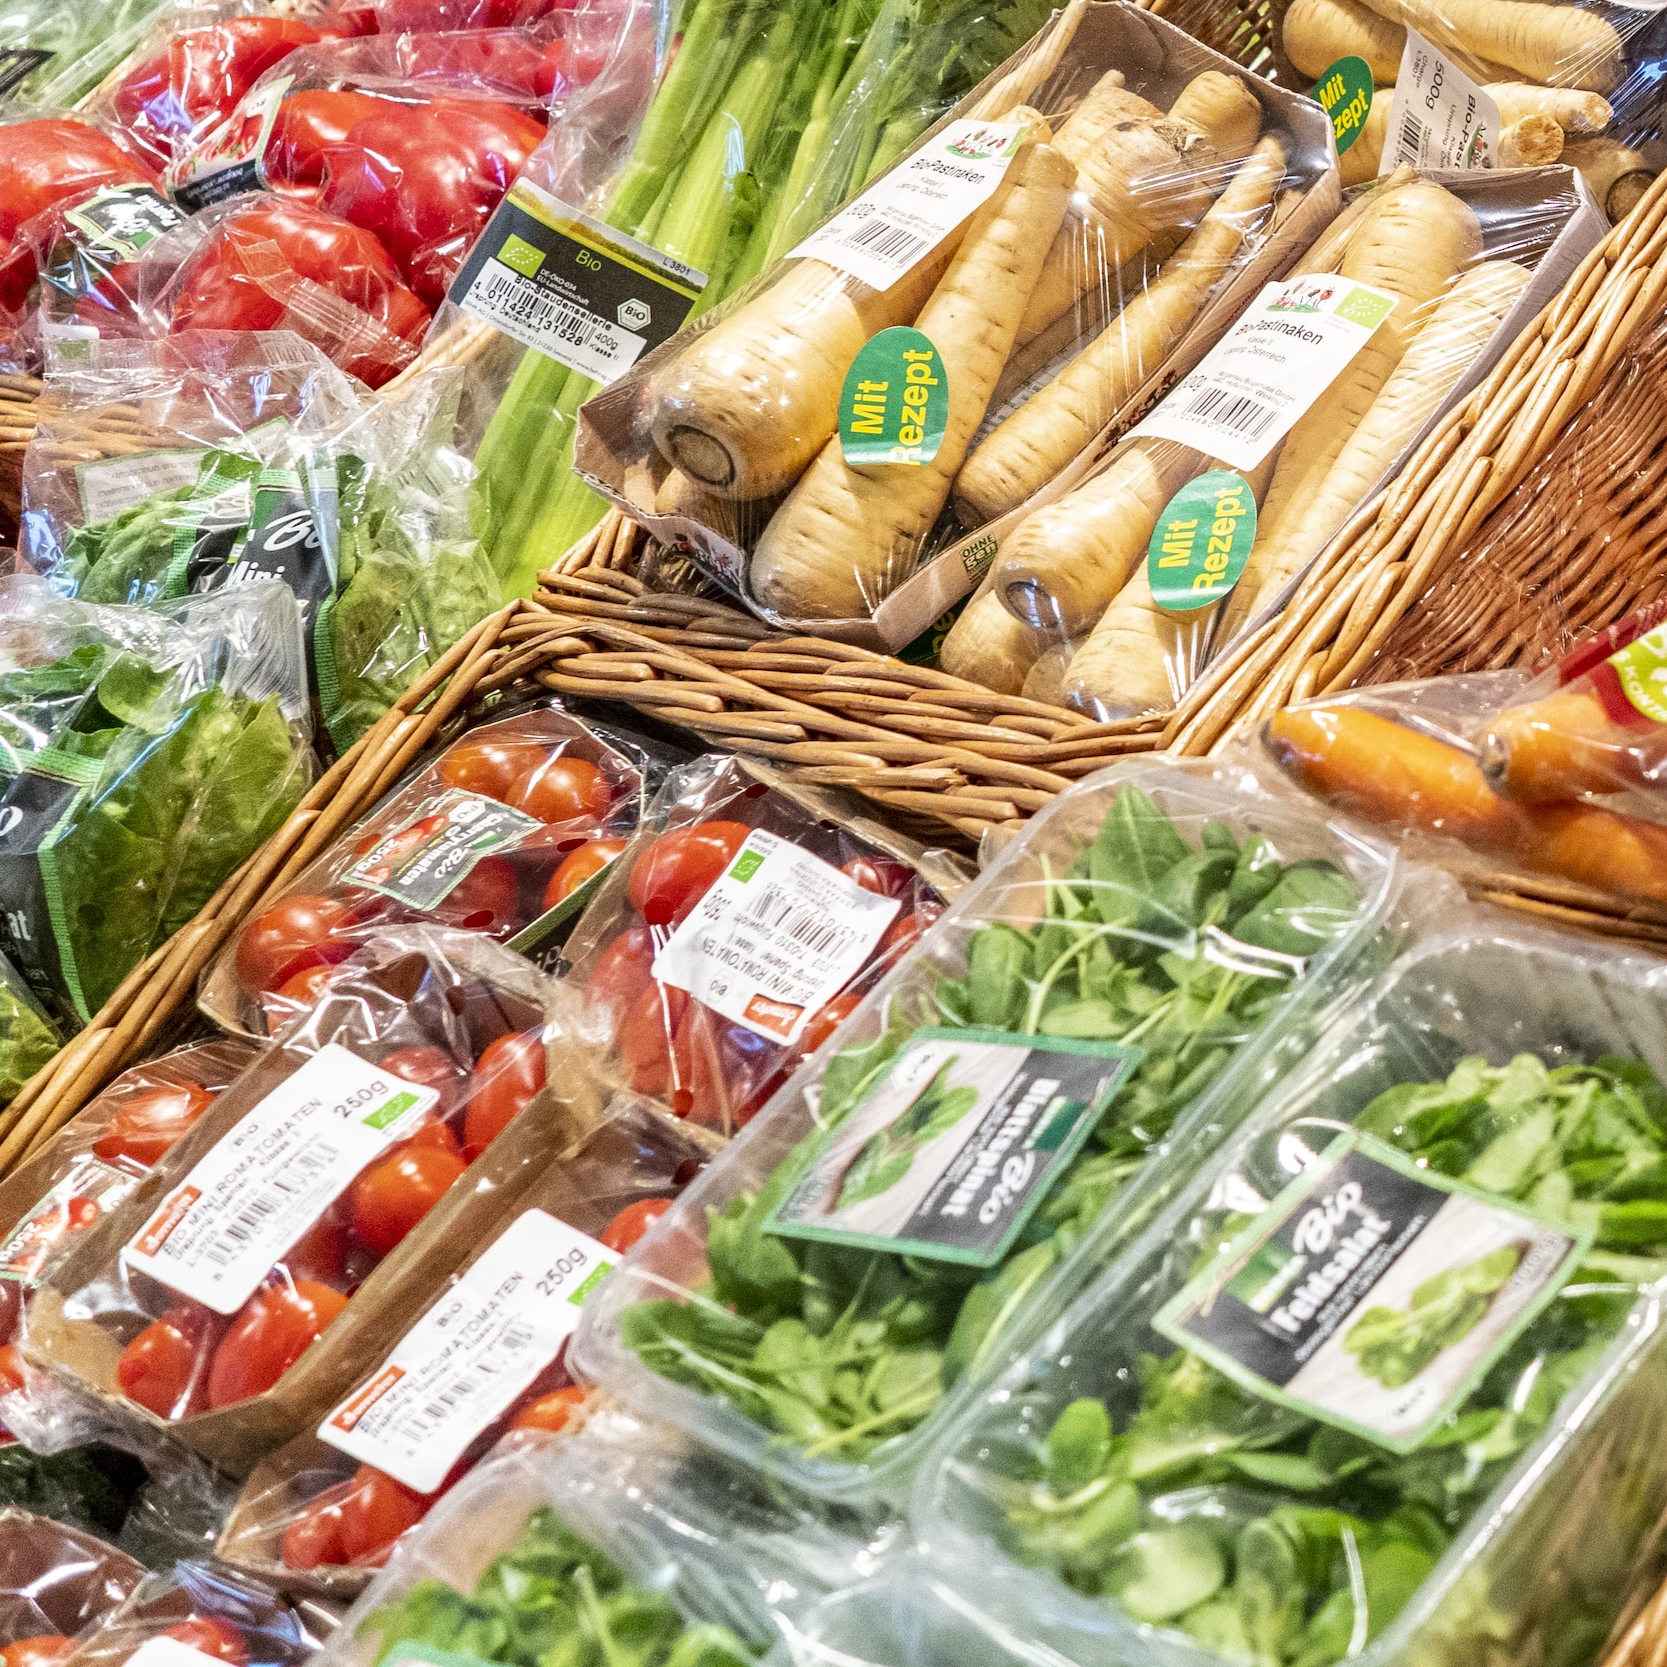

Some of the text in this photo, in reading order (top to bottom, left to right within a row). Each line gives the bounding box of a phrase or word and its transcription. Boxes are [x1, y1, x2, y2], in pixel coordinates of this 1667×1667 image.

[1318, 72, 1347, 110] Mit
[1425, 60, 1446, 111] 500g
[1333, 88, 1369, 139] zept
[909, 158, 986, 185] Bio-Pastinaken
[536, 275, 591, 307] EU-Landwirtschaft
[670, 260, 692, 277] 3801
[473, 280, 584, 347] 4 011424 131528
[513, 275, 613, 332] Bio-Staudensellerie
[588, 342, 613, 360] Klasse
[594, 332, 620, 351] 400g
[1234, 318, 1324, 346] Bio-Pastinaken
[1247, 344, 1288, 365] Österreich
[850, 379, 889, 436] Mit
[888, 348, 939, 466] Rezept
[962, 532, 996, 559] OHNE
[965, 540, 999, 573] gen
[1158, 518, 1199, 569] Mit
[1191, 484, 1245, 597] Rezept
[360, 837, 402, 873] 250g
[397, 812, 505, 887] Cherrytomaten
[433, 846, 470, 880] Bio
[700, 935, 769, 985] ROMATOMATEN
[773, 936, 810, 961] T-0310
[750, 999, 798, 1027] demeter
[791, 986, 816, 1004] BIO
[333, 1079, 390, 1120] 250g
[215, 1095, 324, 1194] ROMATOMATEN
[940, 1078, 1062, 1217] Blattspinat
[978, 1150, 1036, 1225] Bio
[1292, 1180, 1364, 1254] Bio
[535, 1245, 588, 1298] 250g
[1267, 1216, 1393, 1335] Feldsalat
